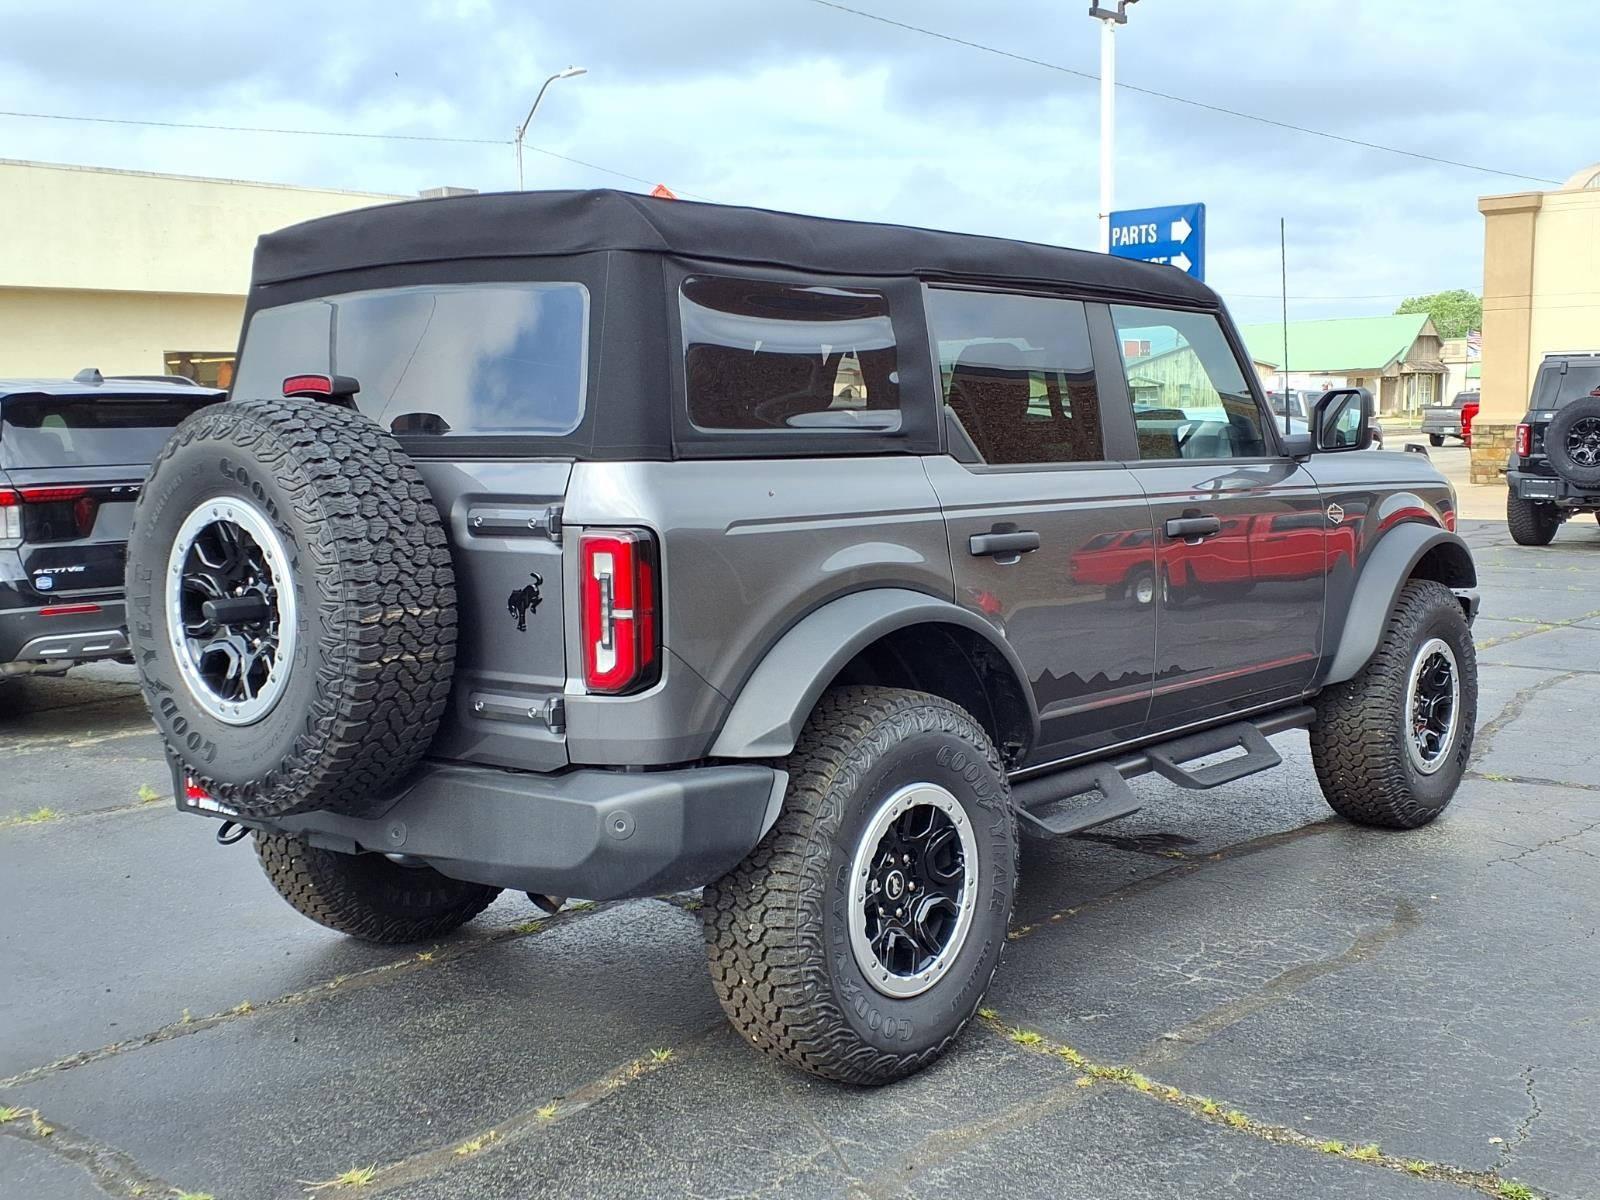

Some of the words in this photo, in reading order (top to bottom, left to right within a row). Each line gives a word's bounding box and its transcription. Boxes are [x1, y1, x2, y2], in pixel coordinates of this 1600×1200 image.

[1112, 223, 1157, 247] PARTS
[32, 565, 87, 575] ACTIVE
[935, 744, 1008, 914] GOODYEAR
